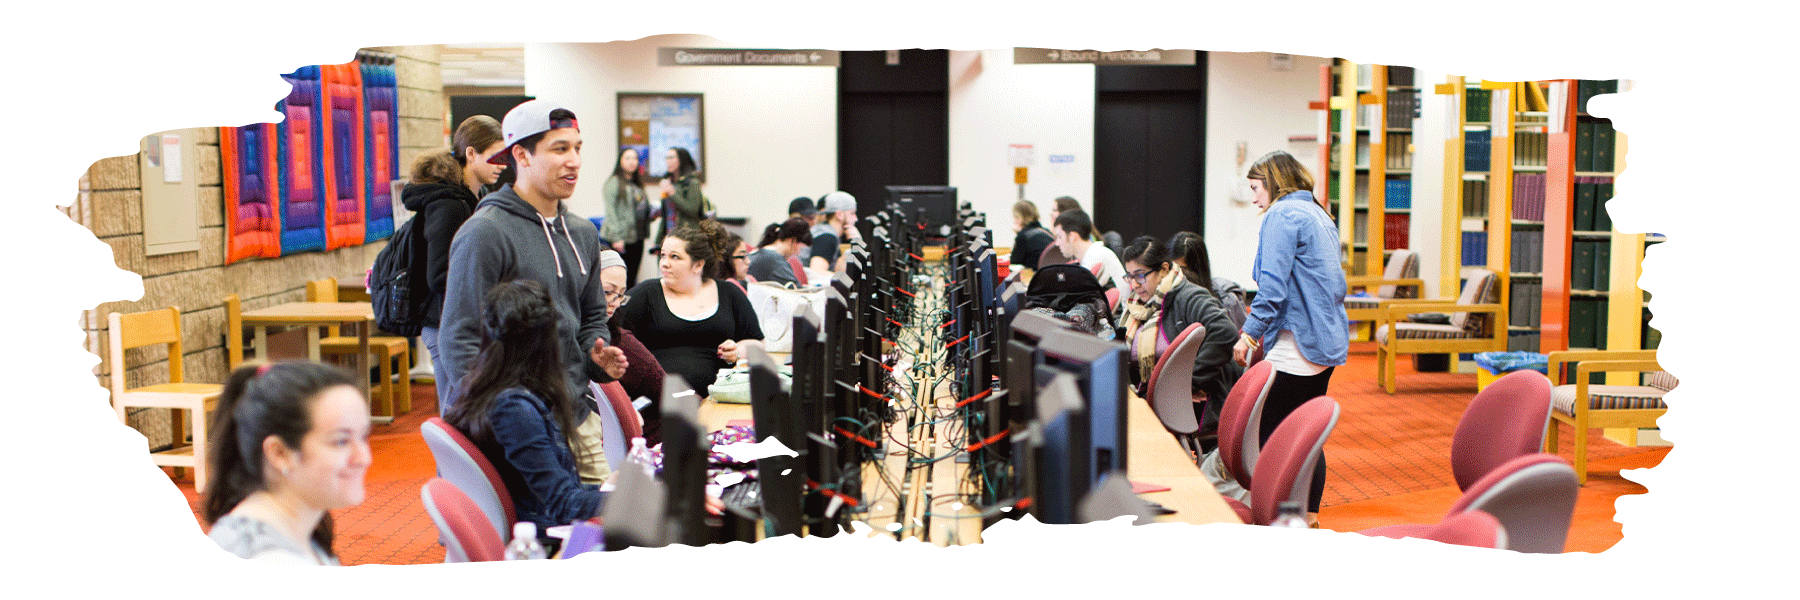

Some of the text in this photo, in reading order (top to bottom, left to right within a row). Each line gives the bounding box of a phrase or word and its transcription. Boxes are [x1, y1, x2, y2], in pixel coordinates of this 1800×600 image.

[674, 50, 807, 64] Government Documents
[1061, 49, 1099, 61] Bound
